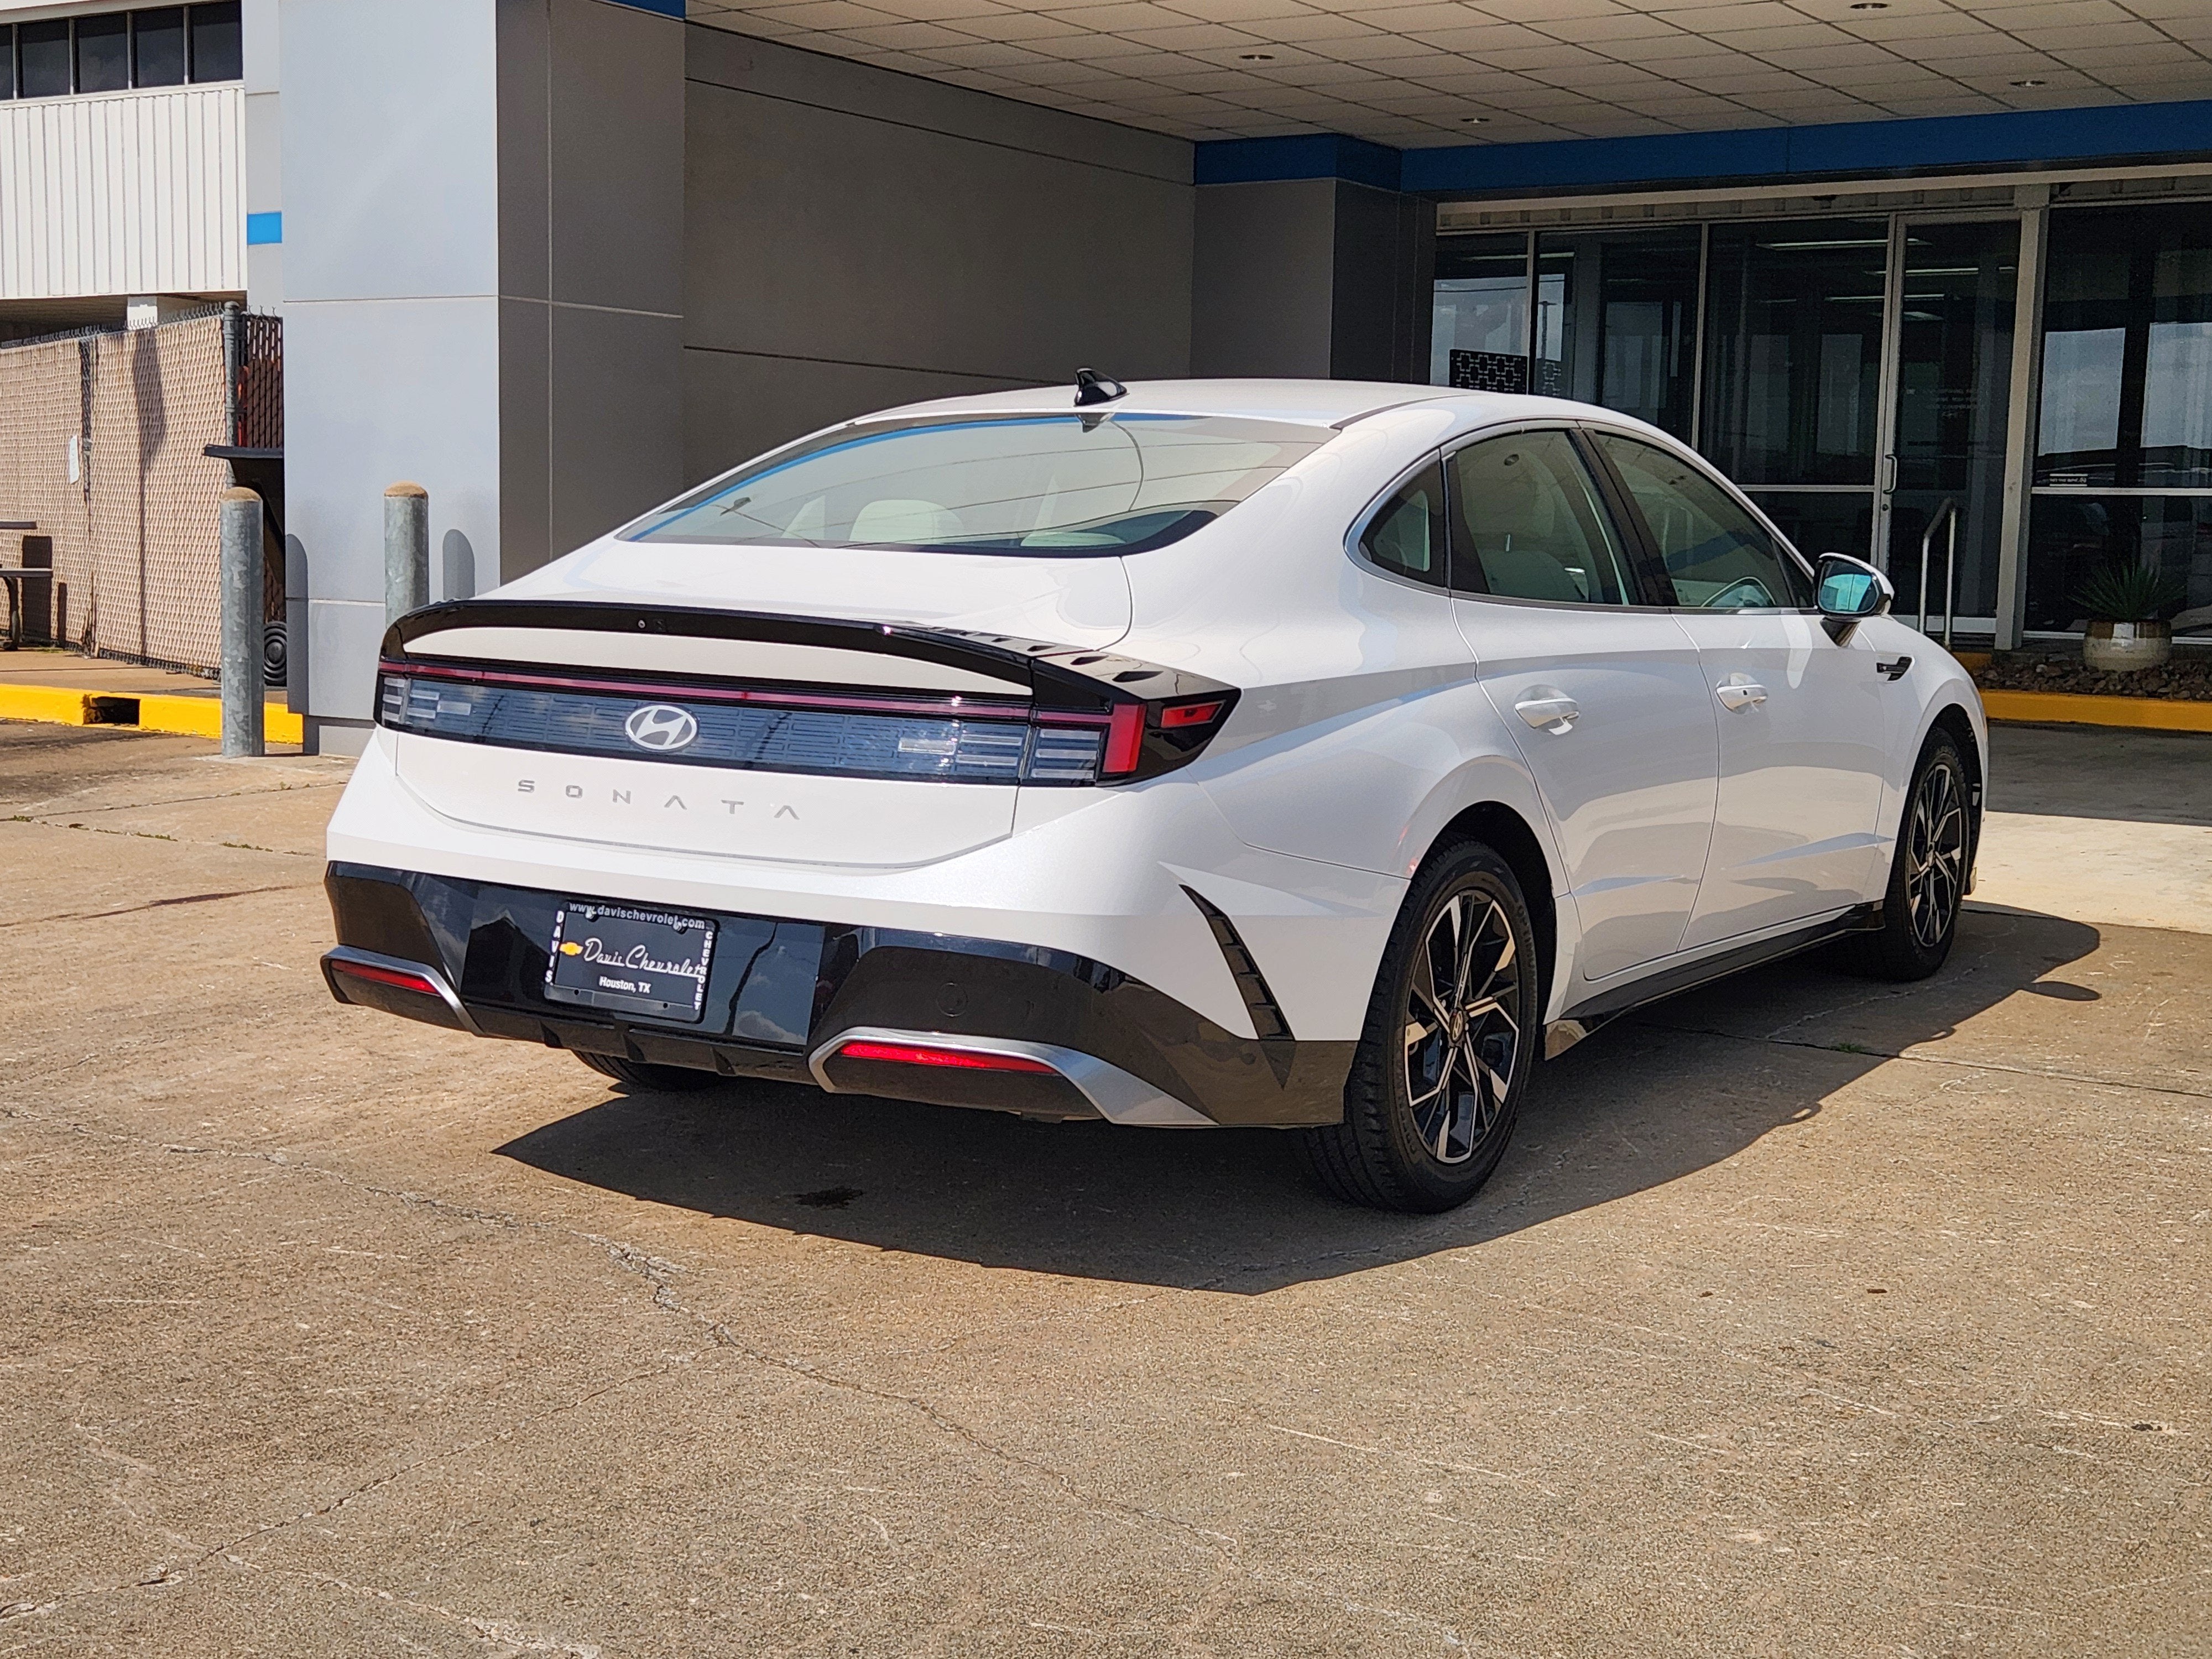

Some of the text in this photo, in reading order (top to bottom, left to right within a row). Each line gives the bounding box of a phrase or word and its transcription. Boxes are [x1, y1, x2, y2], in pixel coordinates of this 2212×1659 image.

[518, 779, 800, 820] SONATA
[545, 910, 565, 983] DAVIS
[583, 937, 701, 978] Davis Chevrolet
[599, 975, 651, 994] Houston, TX
[692, 931, 713, 1010] CHEVROLET
